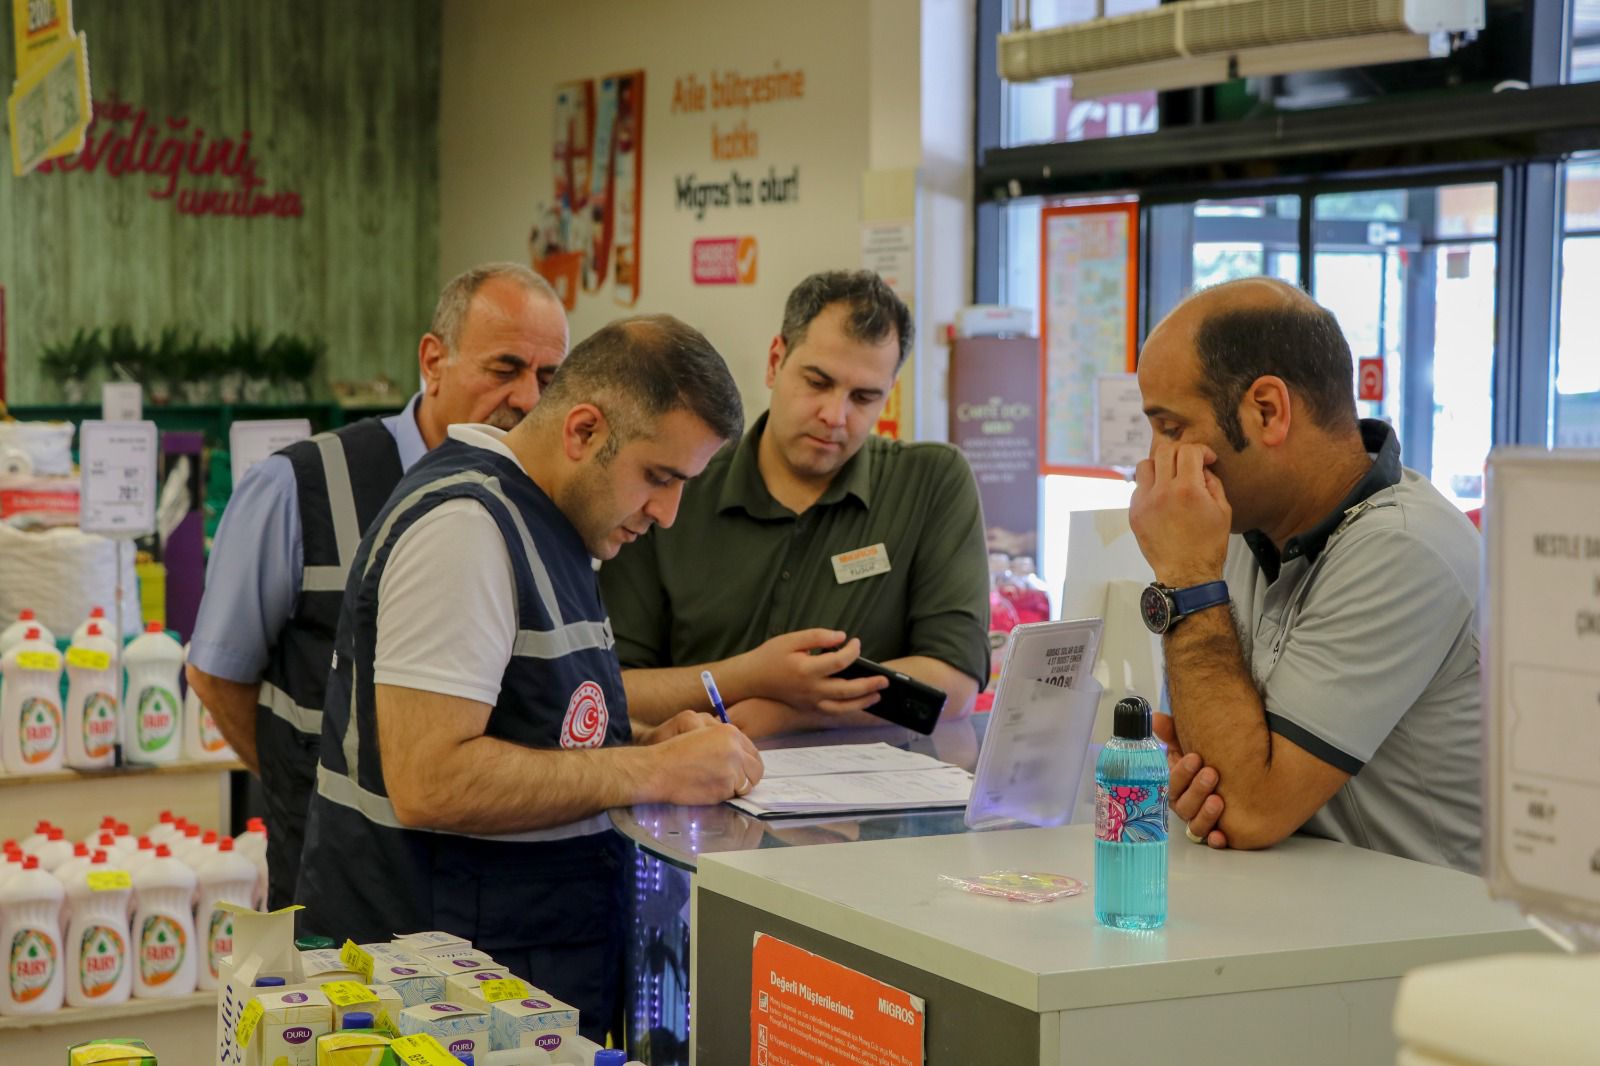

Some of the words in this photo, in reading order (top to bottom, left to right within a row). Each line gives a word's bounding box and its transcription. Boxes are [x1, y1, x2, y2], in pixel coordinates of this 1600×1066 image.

[17, 960, 47, 977] FAIRY
[86, 956, 116, 974] FAIRY
[770, 970, 798, 995] Değerli
[799, 982, 855, 1020] Müşterilerimiz
[286, 1031, 310, 1039] DURU
[452, 1042, 473, 1051] DURU
[538, 1037, 561, 1048] DURU
